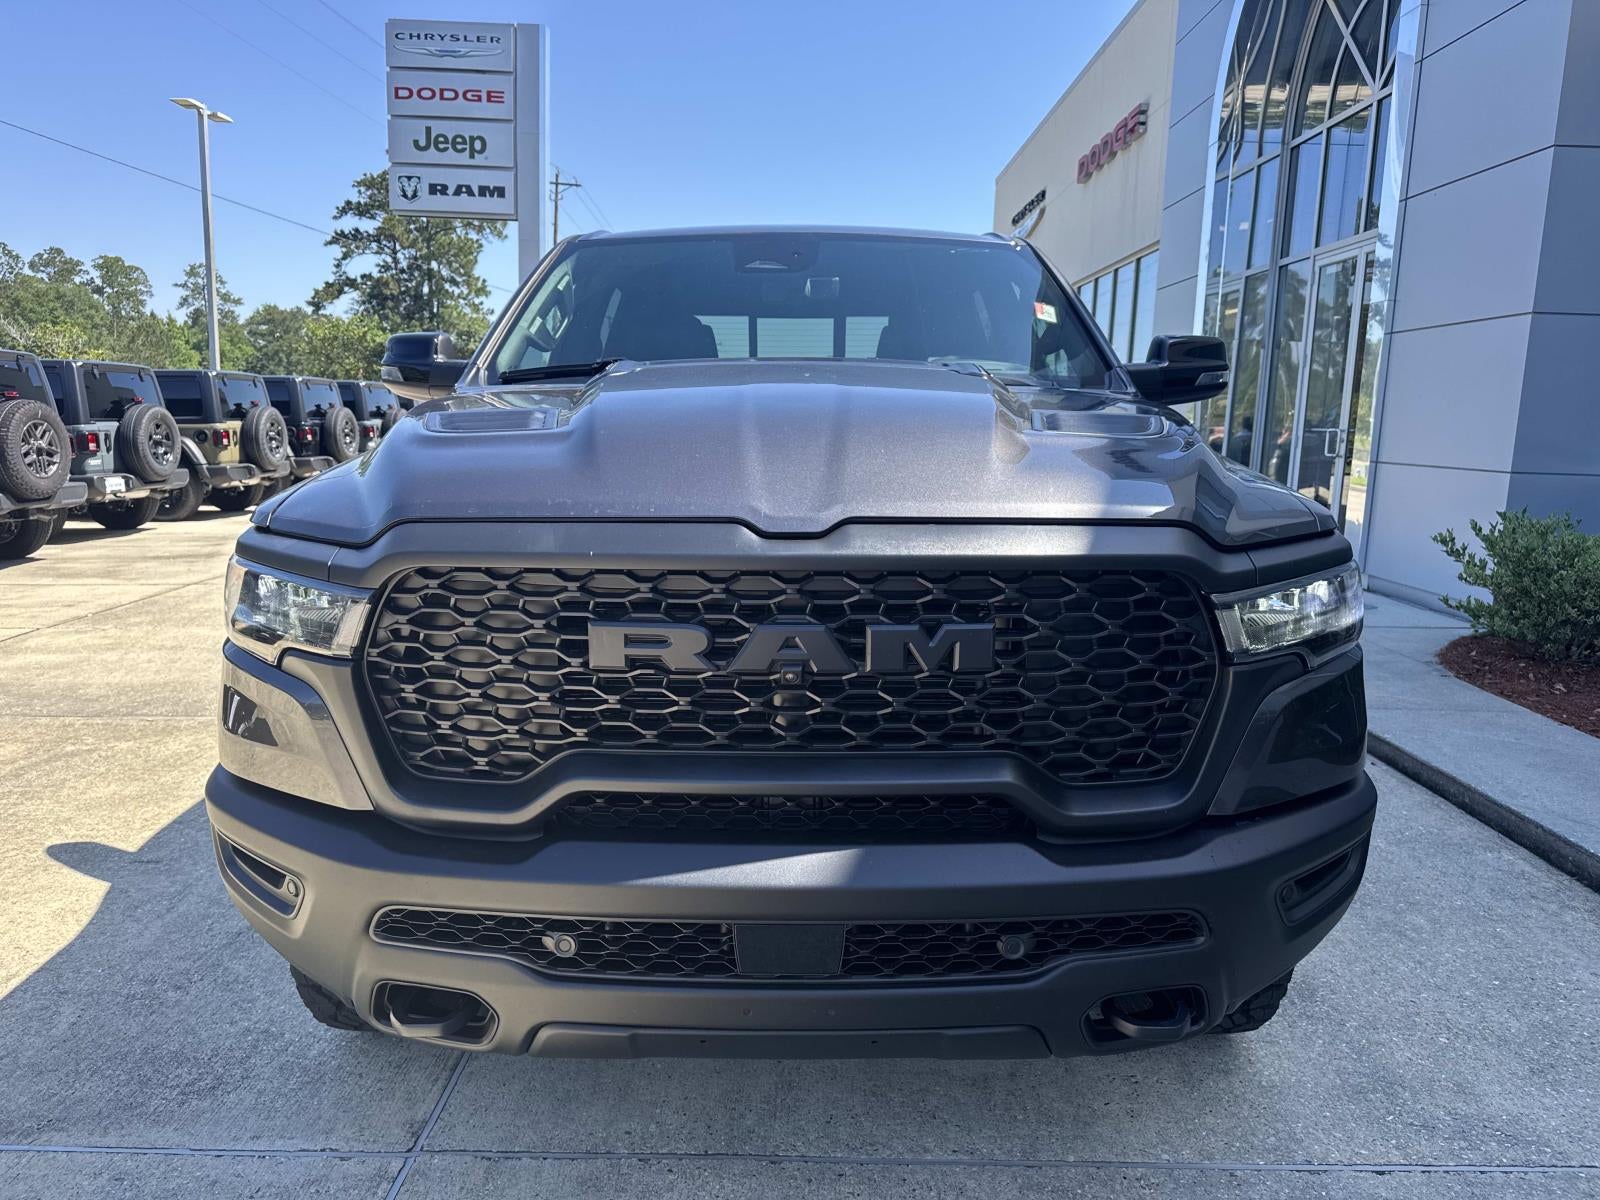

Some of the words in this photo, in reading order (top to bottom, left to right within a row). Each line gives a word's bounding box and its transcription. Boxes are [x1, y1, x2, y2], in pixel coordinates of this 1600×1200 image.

[394, 32, 502, 45] CHRYSLER
[394, 86, 505, 104] DODGE
[412, 125, 488, 160] Jeep
[1077, 102, 1150, 185] DODGE
[428, 183, 506, 199] RAM
[587, 621, 996, 674] RAM
